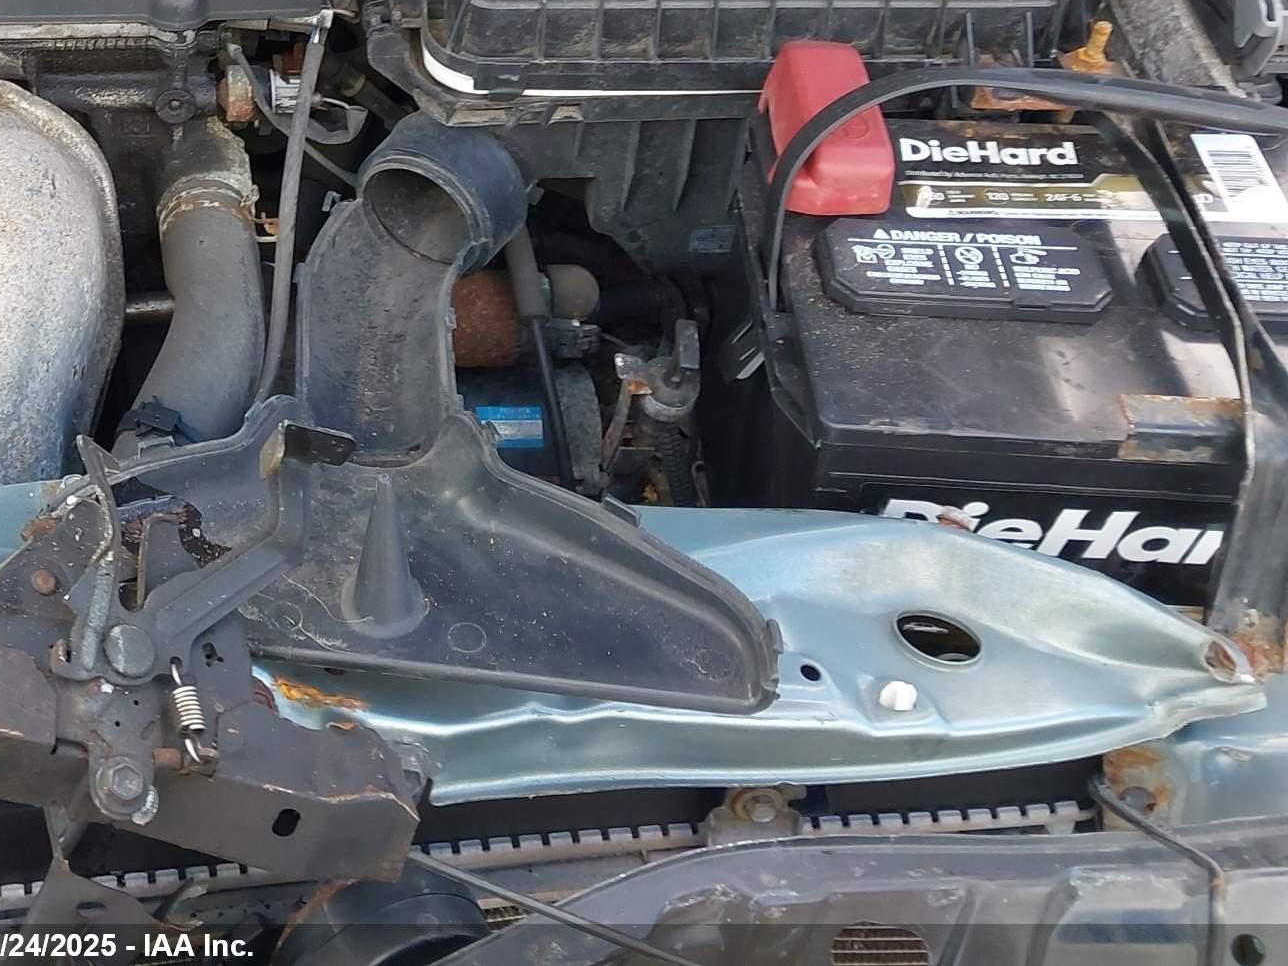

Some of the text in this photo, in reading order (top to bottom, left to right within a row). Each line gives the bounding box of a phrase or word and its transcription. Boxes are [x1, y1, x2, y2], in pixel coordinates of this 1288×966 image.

[898, 137, 1080, 166] DieHard
[890, 229, 961, 243] DANGER
[976, 233, 1043, 246] POISON
[882, 497, 1225, 566] DieHar
